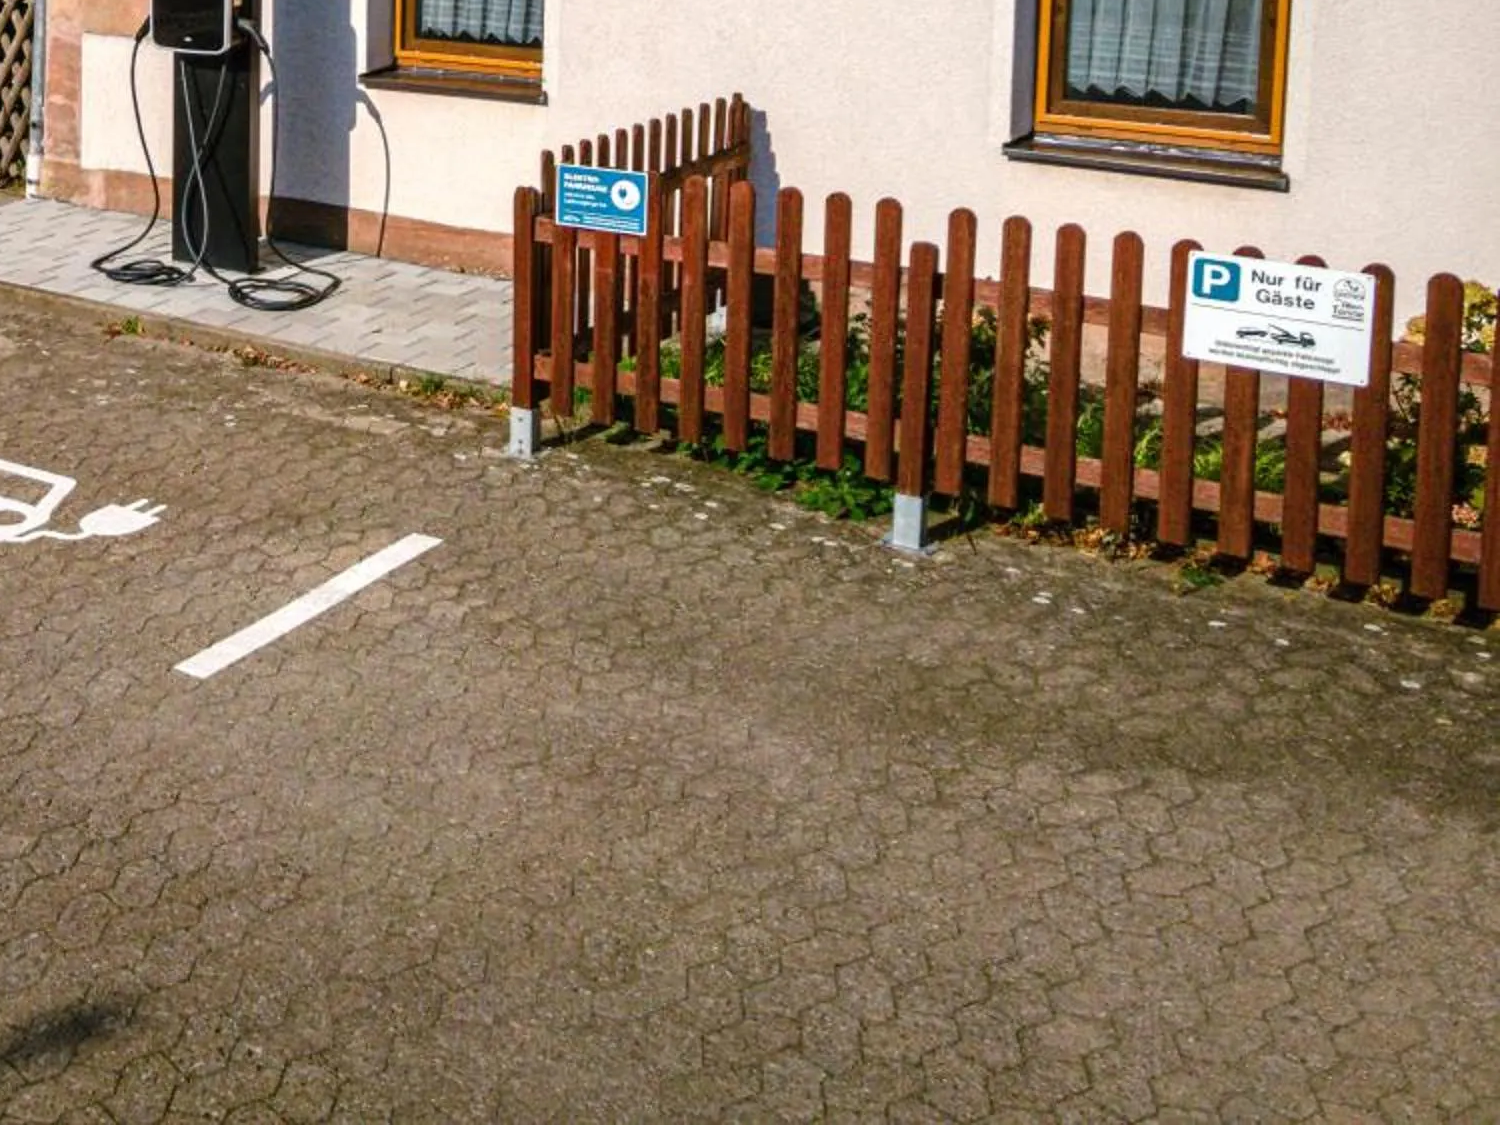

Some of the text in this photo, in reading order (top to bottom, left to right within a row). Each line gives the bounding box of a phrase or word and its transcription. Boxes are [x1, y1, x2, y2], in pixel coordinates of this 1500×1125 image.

[1202, 263, 1231, 295] P
[1251, 269, 1323, 293] Nur für
[1255, 288, 1316, 310] Gäste
